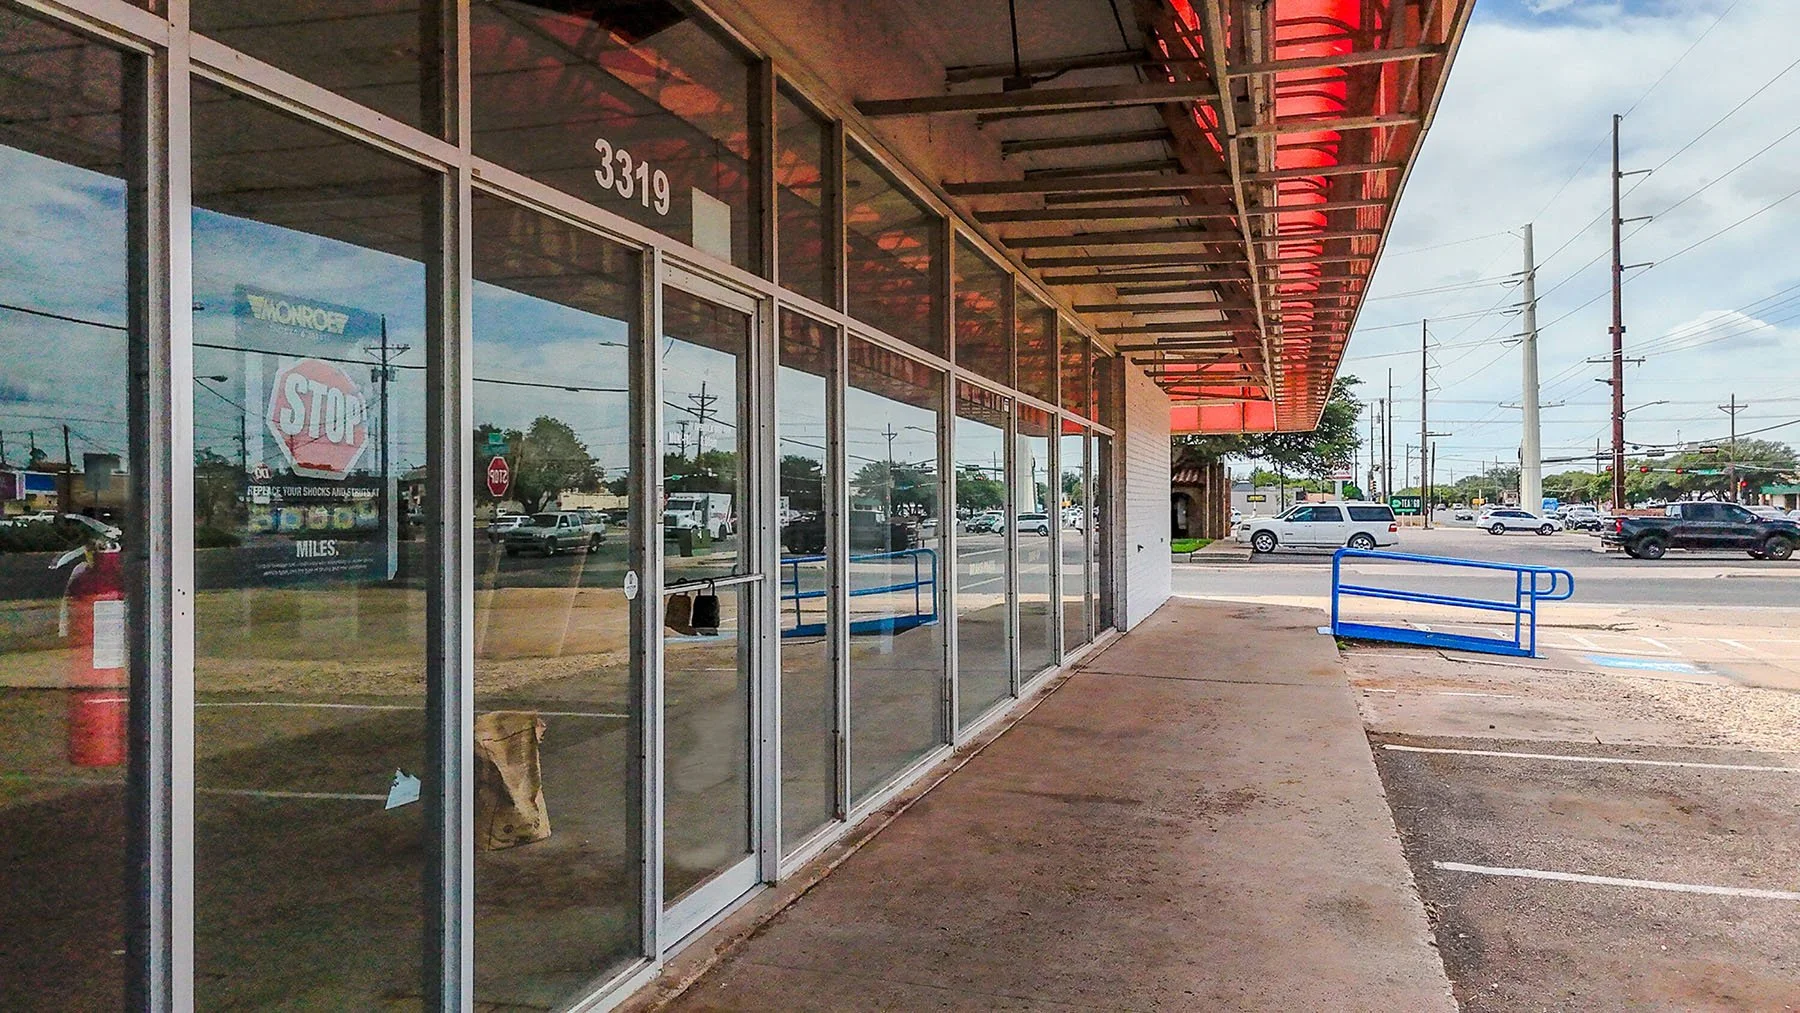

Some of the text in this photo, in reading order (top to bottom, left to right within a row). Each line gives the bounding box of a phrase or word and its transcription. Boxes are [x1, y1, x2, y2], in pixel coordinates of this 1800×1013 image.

[594, 138, 670, 216] 3319
[247, 294, 350, 336] MONROE
[281, 373, 364, 445] STOP
[247, 485, 281, 497] REPLACE
[283, 486, 302, 497] YOUR
[303, 486, 331, 498] SHOCKS
[332, 487, 346, 498] AND
